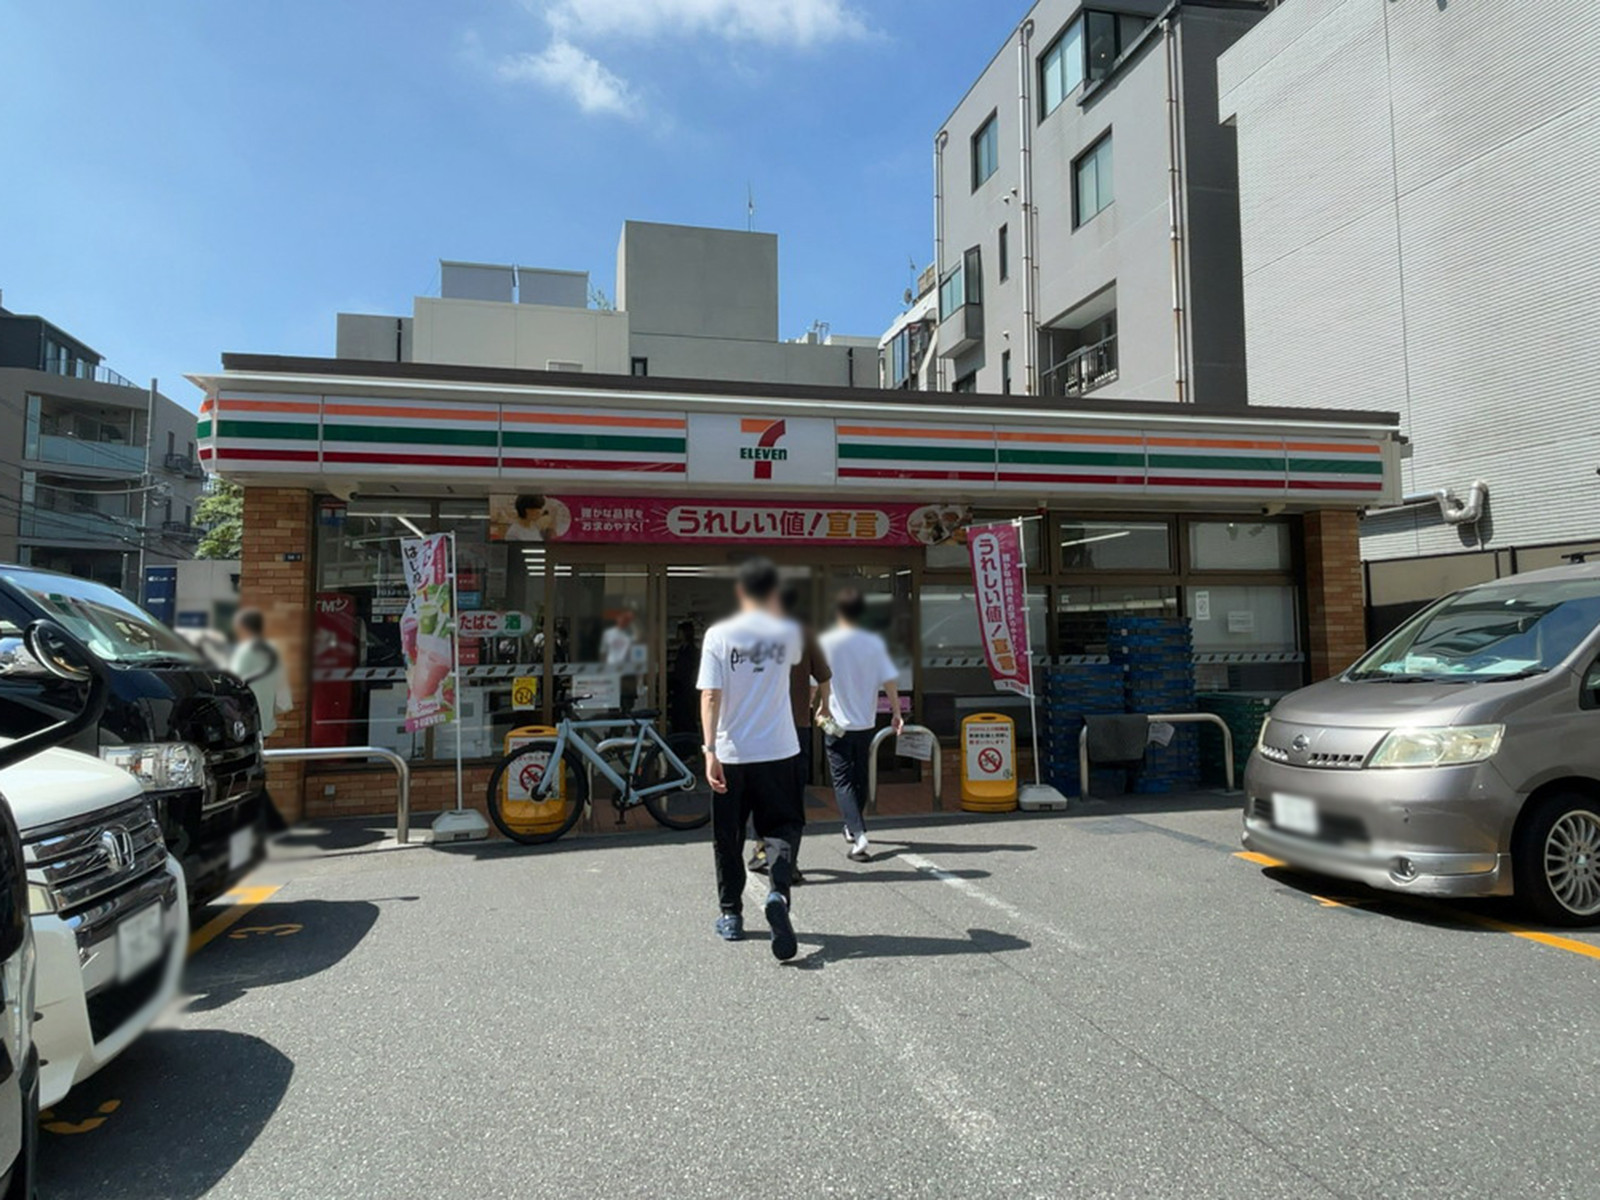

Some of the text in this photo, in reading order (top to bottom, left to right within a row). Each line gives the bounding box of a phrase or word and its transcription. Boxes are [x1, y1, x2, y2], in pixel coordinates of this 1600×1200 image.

[740, 418, 786, 479] 7
[459, 613, 522, 631] たばこ 酒
